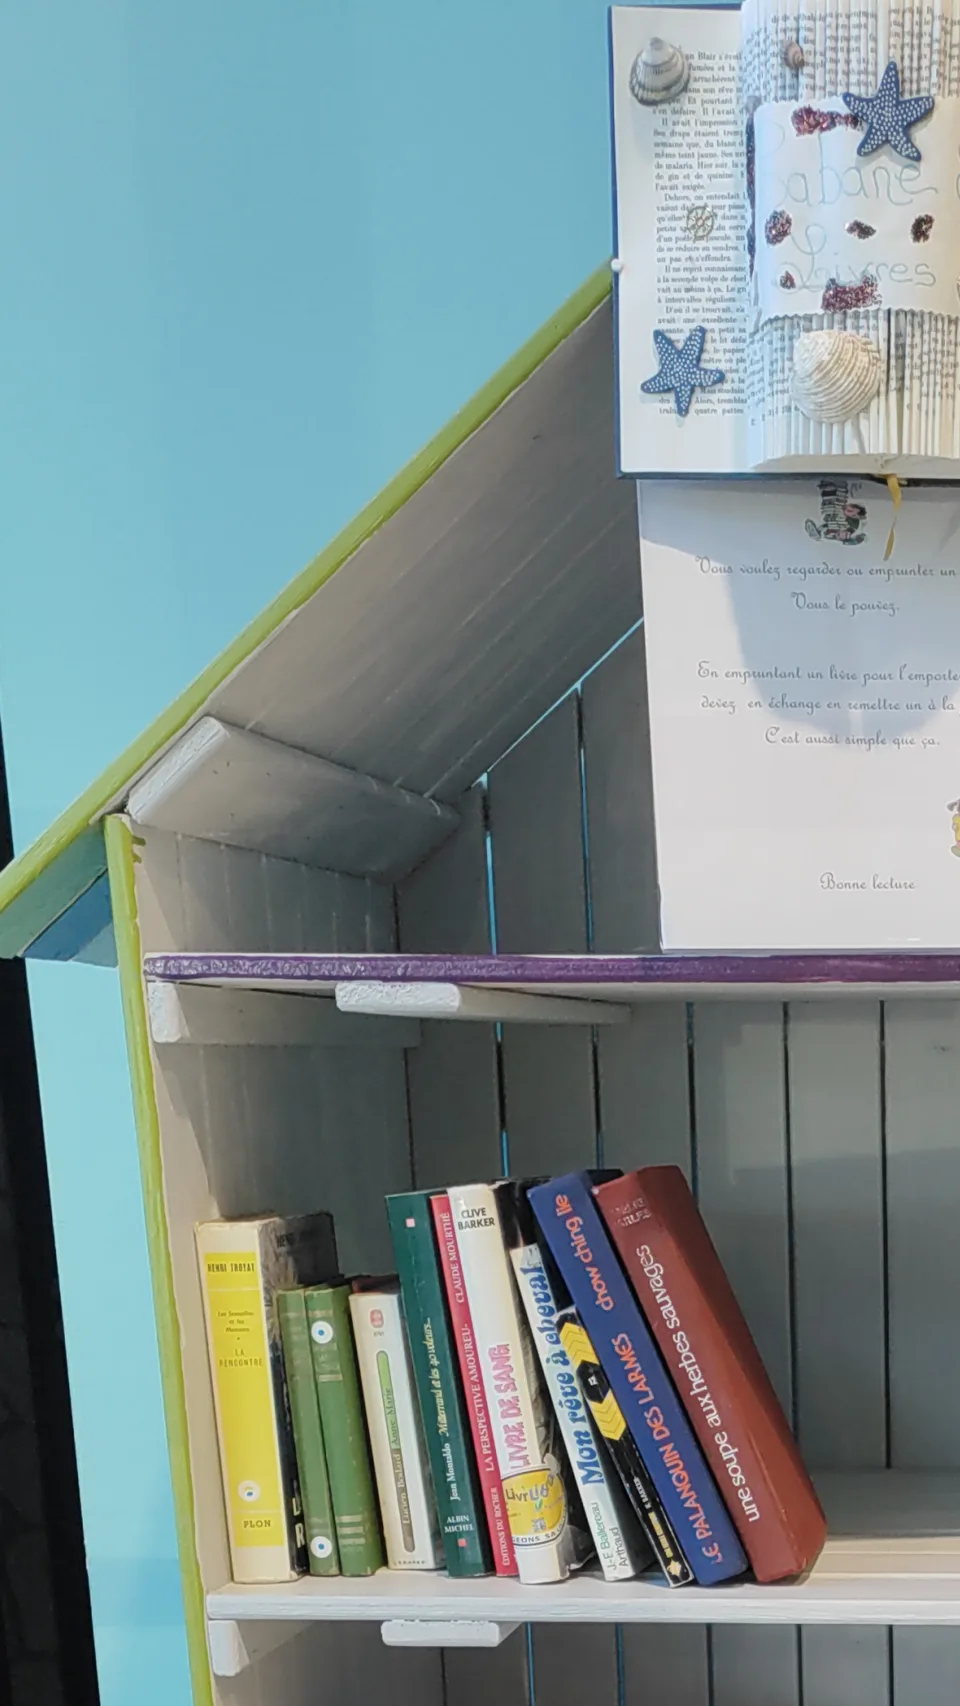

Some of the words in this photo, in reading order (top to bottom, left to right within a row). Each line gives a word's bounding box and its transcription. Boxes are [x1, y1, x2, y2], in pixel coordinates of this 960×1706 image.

[695, 556, 734, 574] Vous
[739, 560, 780, 580] voulez
[786, 562, 841, 581] regarder
[846, 567, 863, 576] ou
[868, 563, 935, 582] emprunter
[940, 568, 956, 577] un
[697, 660, 718, 679] En
[724, 666, 801, 685] empruntant
[807, 671, 823, 680] un
[829, 665, 858, 681] livre
[862, 672, 893, 687] pour
[701, 696, 736, 714] devez
[747, 701, 763, 710] en
[768, 694, 822, 716] échange
[826, 701, 842, 710] en
[848, 697, 901, 711] remettre
[905, 702, 922, 711] un
[928, 697, 938, 711] à
[942, 696, 955, 711] la
[820, 872, 867, 890] Bonne
[872, 873, 916, 890] lecture
[461, 1207, 487, 1219] CLIVE
[549, 1190, 573, 1216] lie
[458, 1218, 495, 1230] BARKER
[559, 1212, 599, 1265] ching
[580, 1261, 616, 1314] chow
[633, 1241, 685, 1330] sauvages
[519, 1262, 564, 1348] cheval
[486, 1343, 517, 1394] SANG
[543, 1348, 570, 1370] à
[611, 1330, 655, 1404] LARMES
[667, 1330, 708, 1395] herbes
[497, 1395, 522, 1419] DE
[549, 1369, 586, 1427] rêve
[694, 1391, 722, 1429] aux
[471, 1384, 491, 1454] PERSPECTIVE
[643, 1404, 670, 1441] DES
[484, 1456, 494, 1471] LA
[501, 1421, 530, 1469] LIVRE
[567, 1426, 604, 1486] Mon
[711, 1428, 750, 1488] soupe
[659, 1440, 714, 1540] PALANQUIN
[736, 1486, 761, 1521] une
[243, 1520, 272, 1528] PLON
